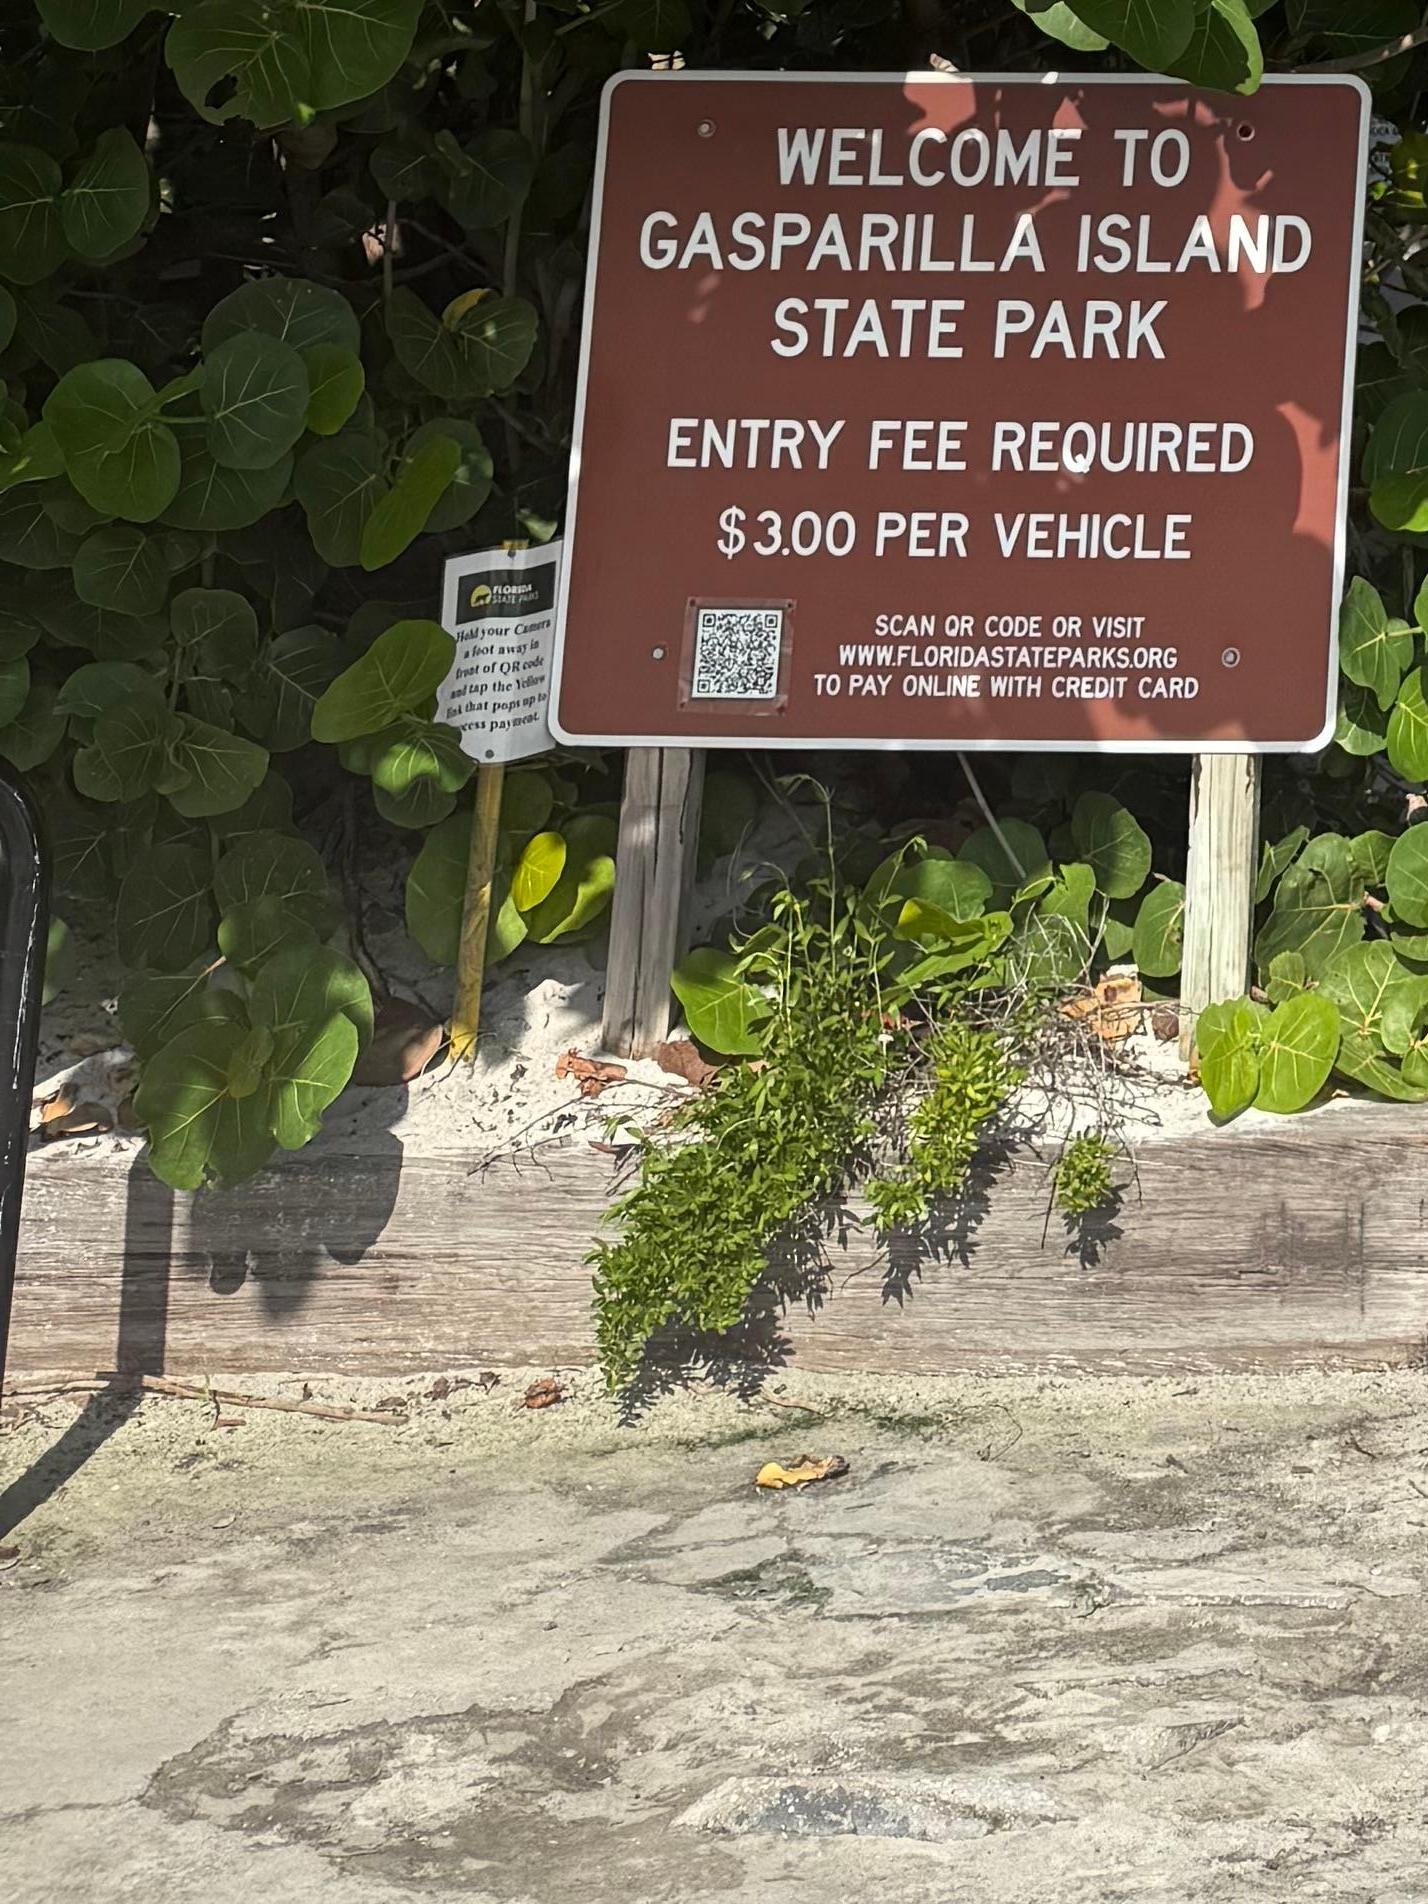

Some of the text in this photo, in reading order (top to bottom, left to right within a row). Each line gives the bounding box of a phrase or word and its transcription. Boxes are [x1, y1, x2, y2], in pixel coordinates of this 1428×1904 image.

[777, 127, 1191, 188] WELCOME TO
[639, 210, 1312, 274] GASPARILLA ISLAND
[770, 297, 1169, 360] STATE PARK
[666, 417, 1254, 474] ENTRY FEE REQUIRED
[717, 505, 1193, 560] $3.00 PER VEHICLE
[480, 627, 511, 641] your
[874, 614, 1146, 639] SCAN QR CODE OR VISIT
[471, 644, 495, 658] foot
[498, 642, 528, 656] away
[838, 644, 1178, 670] WWW.FLORIDASTATEPARKS.ORG
[482, 662, 497, 674] of
[500, 660, 520, 676] QR
[468, 683, 489, 696] tap
[492, 680, 513, 693] the
[813, 673, 1200, 700] TO PAY ONLINE WITH CREDIT CARD
[465, 700, 489, 713] that
